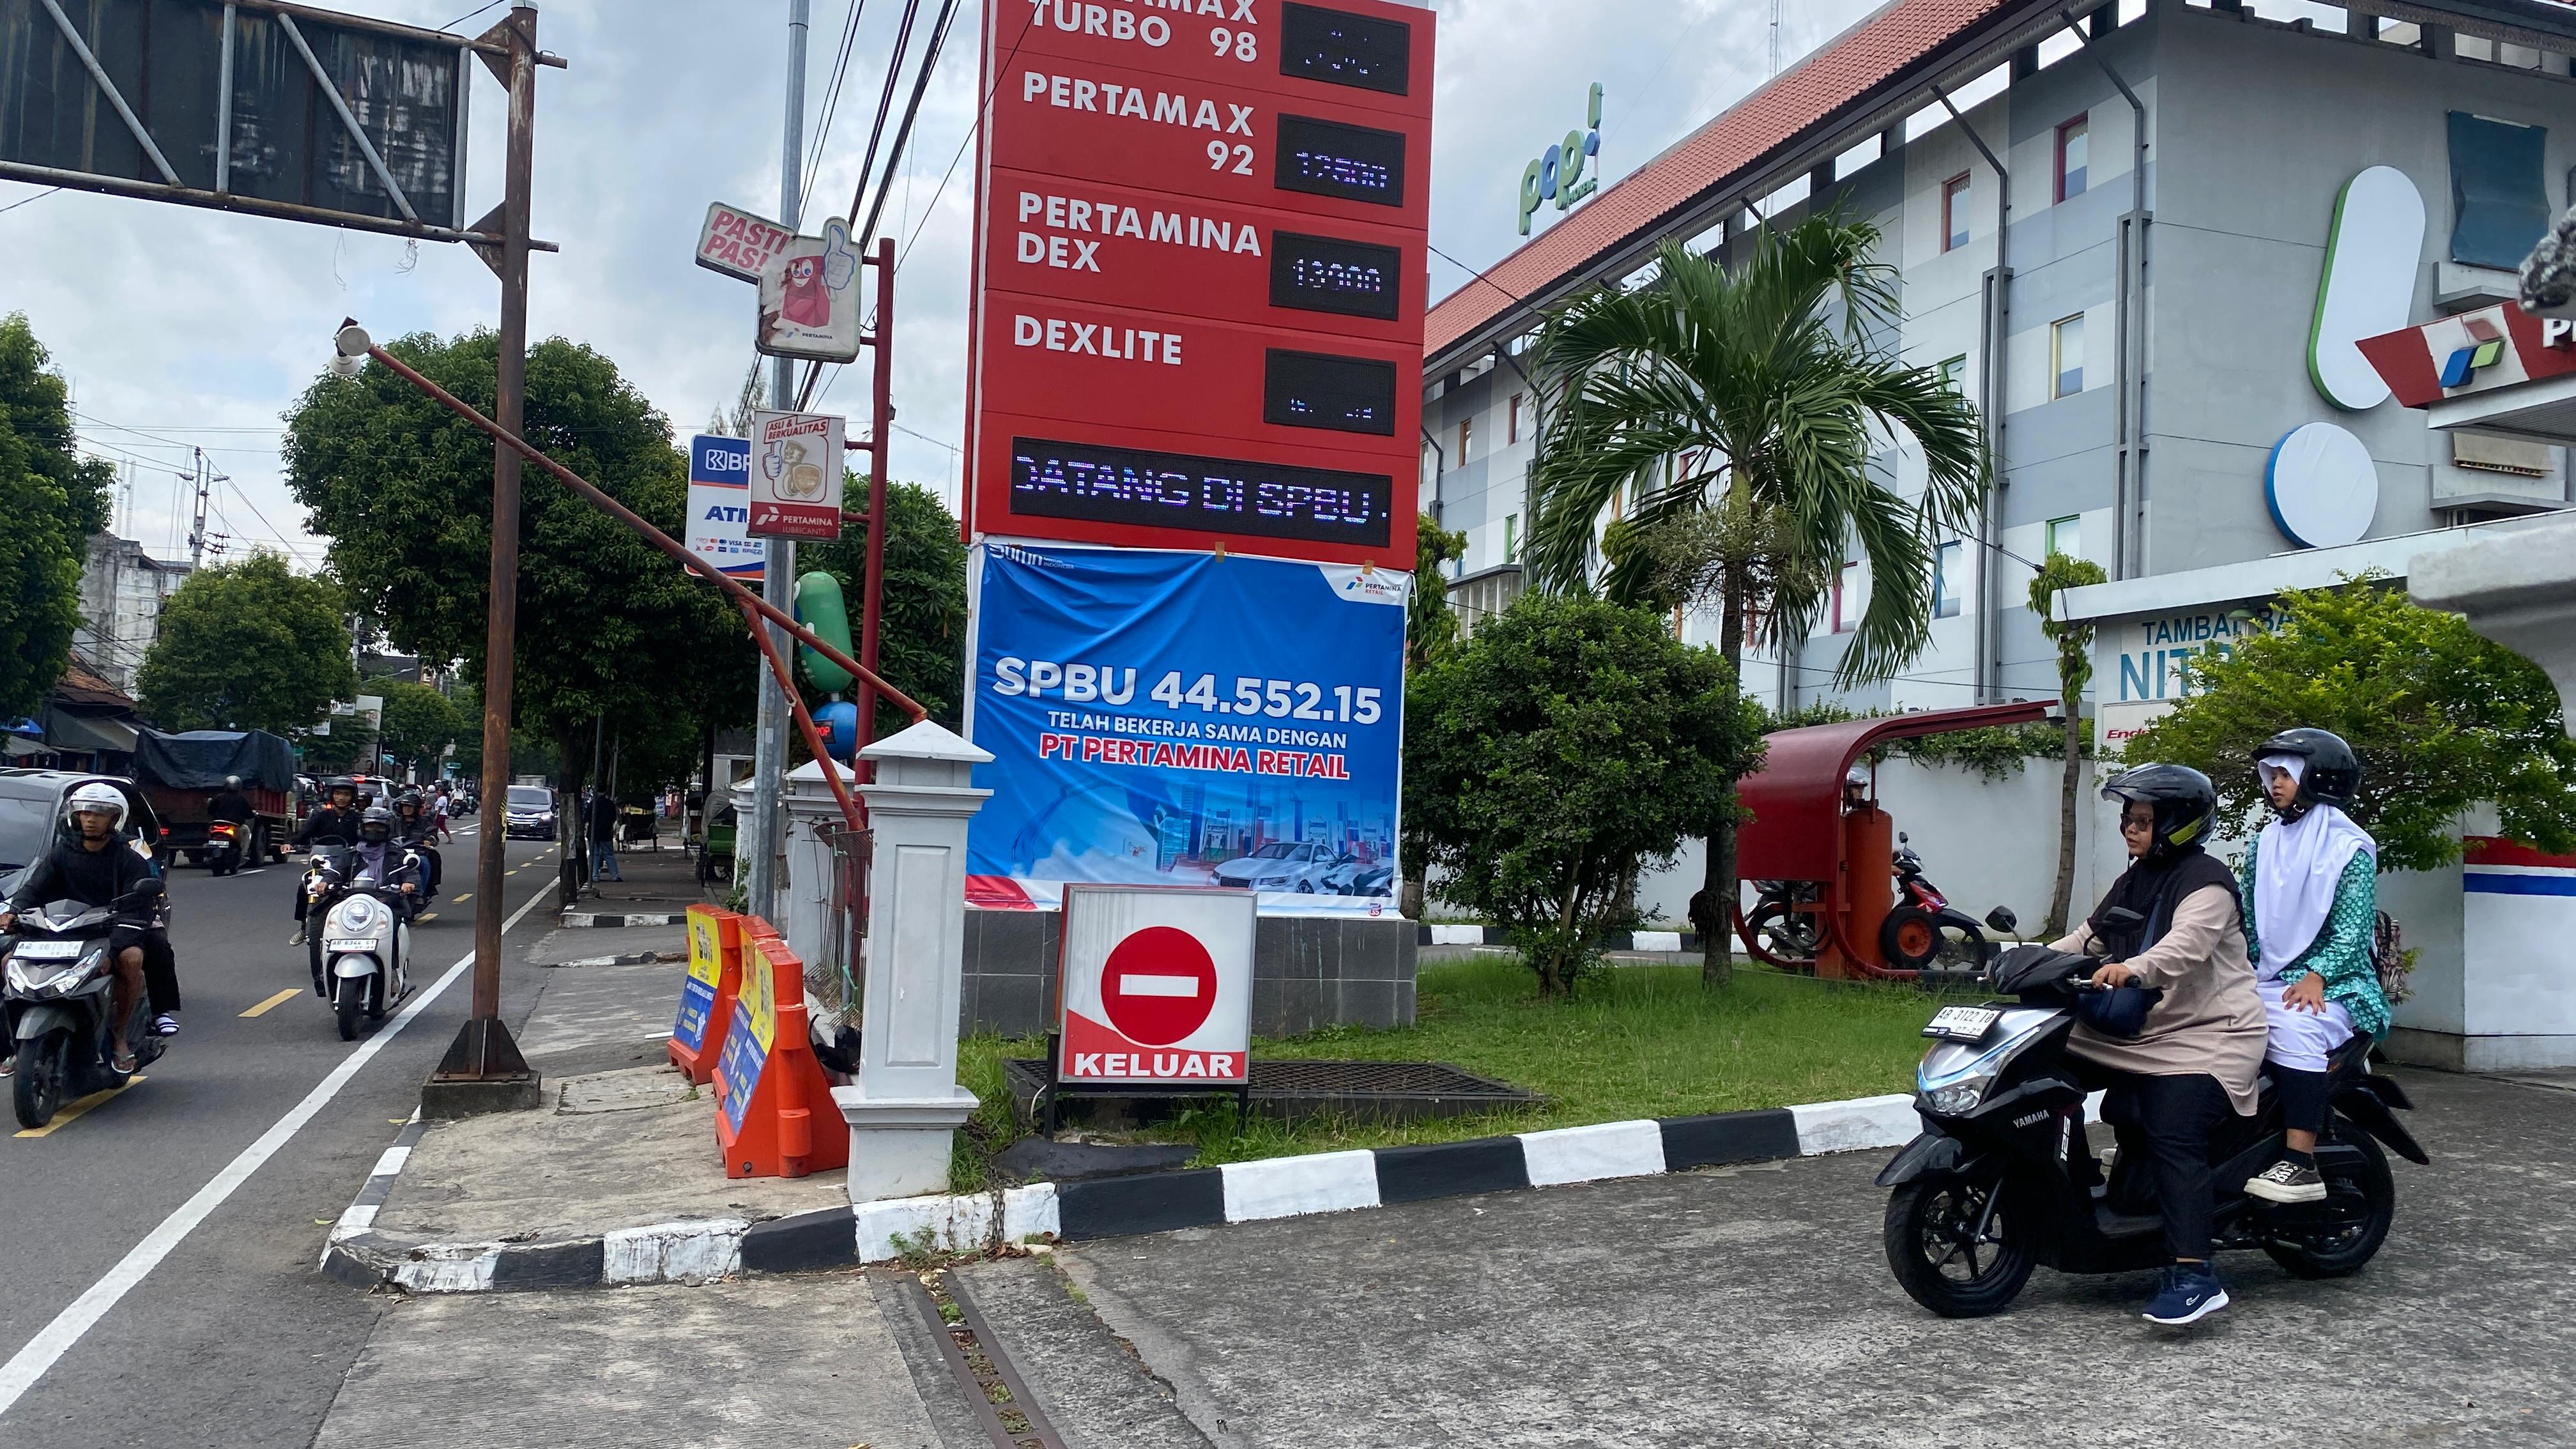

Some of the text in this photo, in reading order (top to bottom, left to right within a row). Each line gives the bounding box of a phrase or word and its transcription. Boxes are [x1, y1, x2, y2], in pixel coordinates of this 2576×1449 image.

[1029, 0, 1170, 47] TURBO
[1210, 27, 1257, 62] 98
[1023, 71, 1255, 137] PERTAMAX
[1207, 140, 1254, 176] 92
[711, 210, 790, 255] PASTI
[1019, 192, 1262, 257] PERTAMINA
[704, 234, 769, 272] PAS!
[1016, 231, 1101, 273] DEX
[1014, 314, 1183, 365] DEXLITE
[768, 421, 827, 440] BERKUALITAS
[769, 420, 785, 431] ASLI
[1203, 477, 1243, 511] DI
[1257, 482, 1369, 523] SPBU
[783, 515, 833, 526] PERTAMINA
[783, 526, 826, 536] LUBRICANTS
[1365, 583, 1402, 592] PERTAMINA
[2257, 607, 2294, 633] BA
[992, 656, 1382, 724] SPBU 44.552.15
[1048, 710, 1347, 749] TELAH BEKERJA SAMA DENGAN
[1039, 733, 1350, 781] PT PERTAMINA RETAIL
[1938, 1009, 1953, 1020] AB
[1954, 1010, 1980, 1022] 3122
[1074, 1052, 1234, 1078] KELUAR
[2013, 1109, 2050, 1128] YAMAHA
[2060, 1115, 2071, 1162] 125
